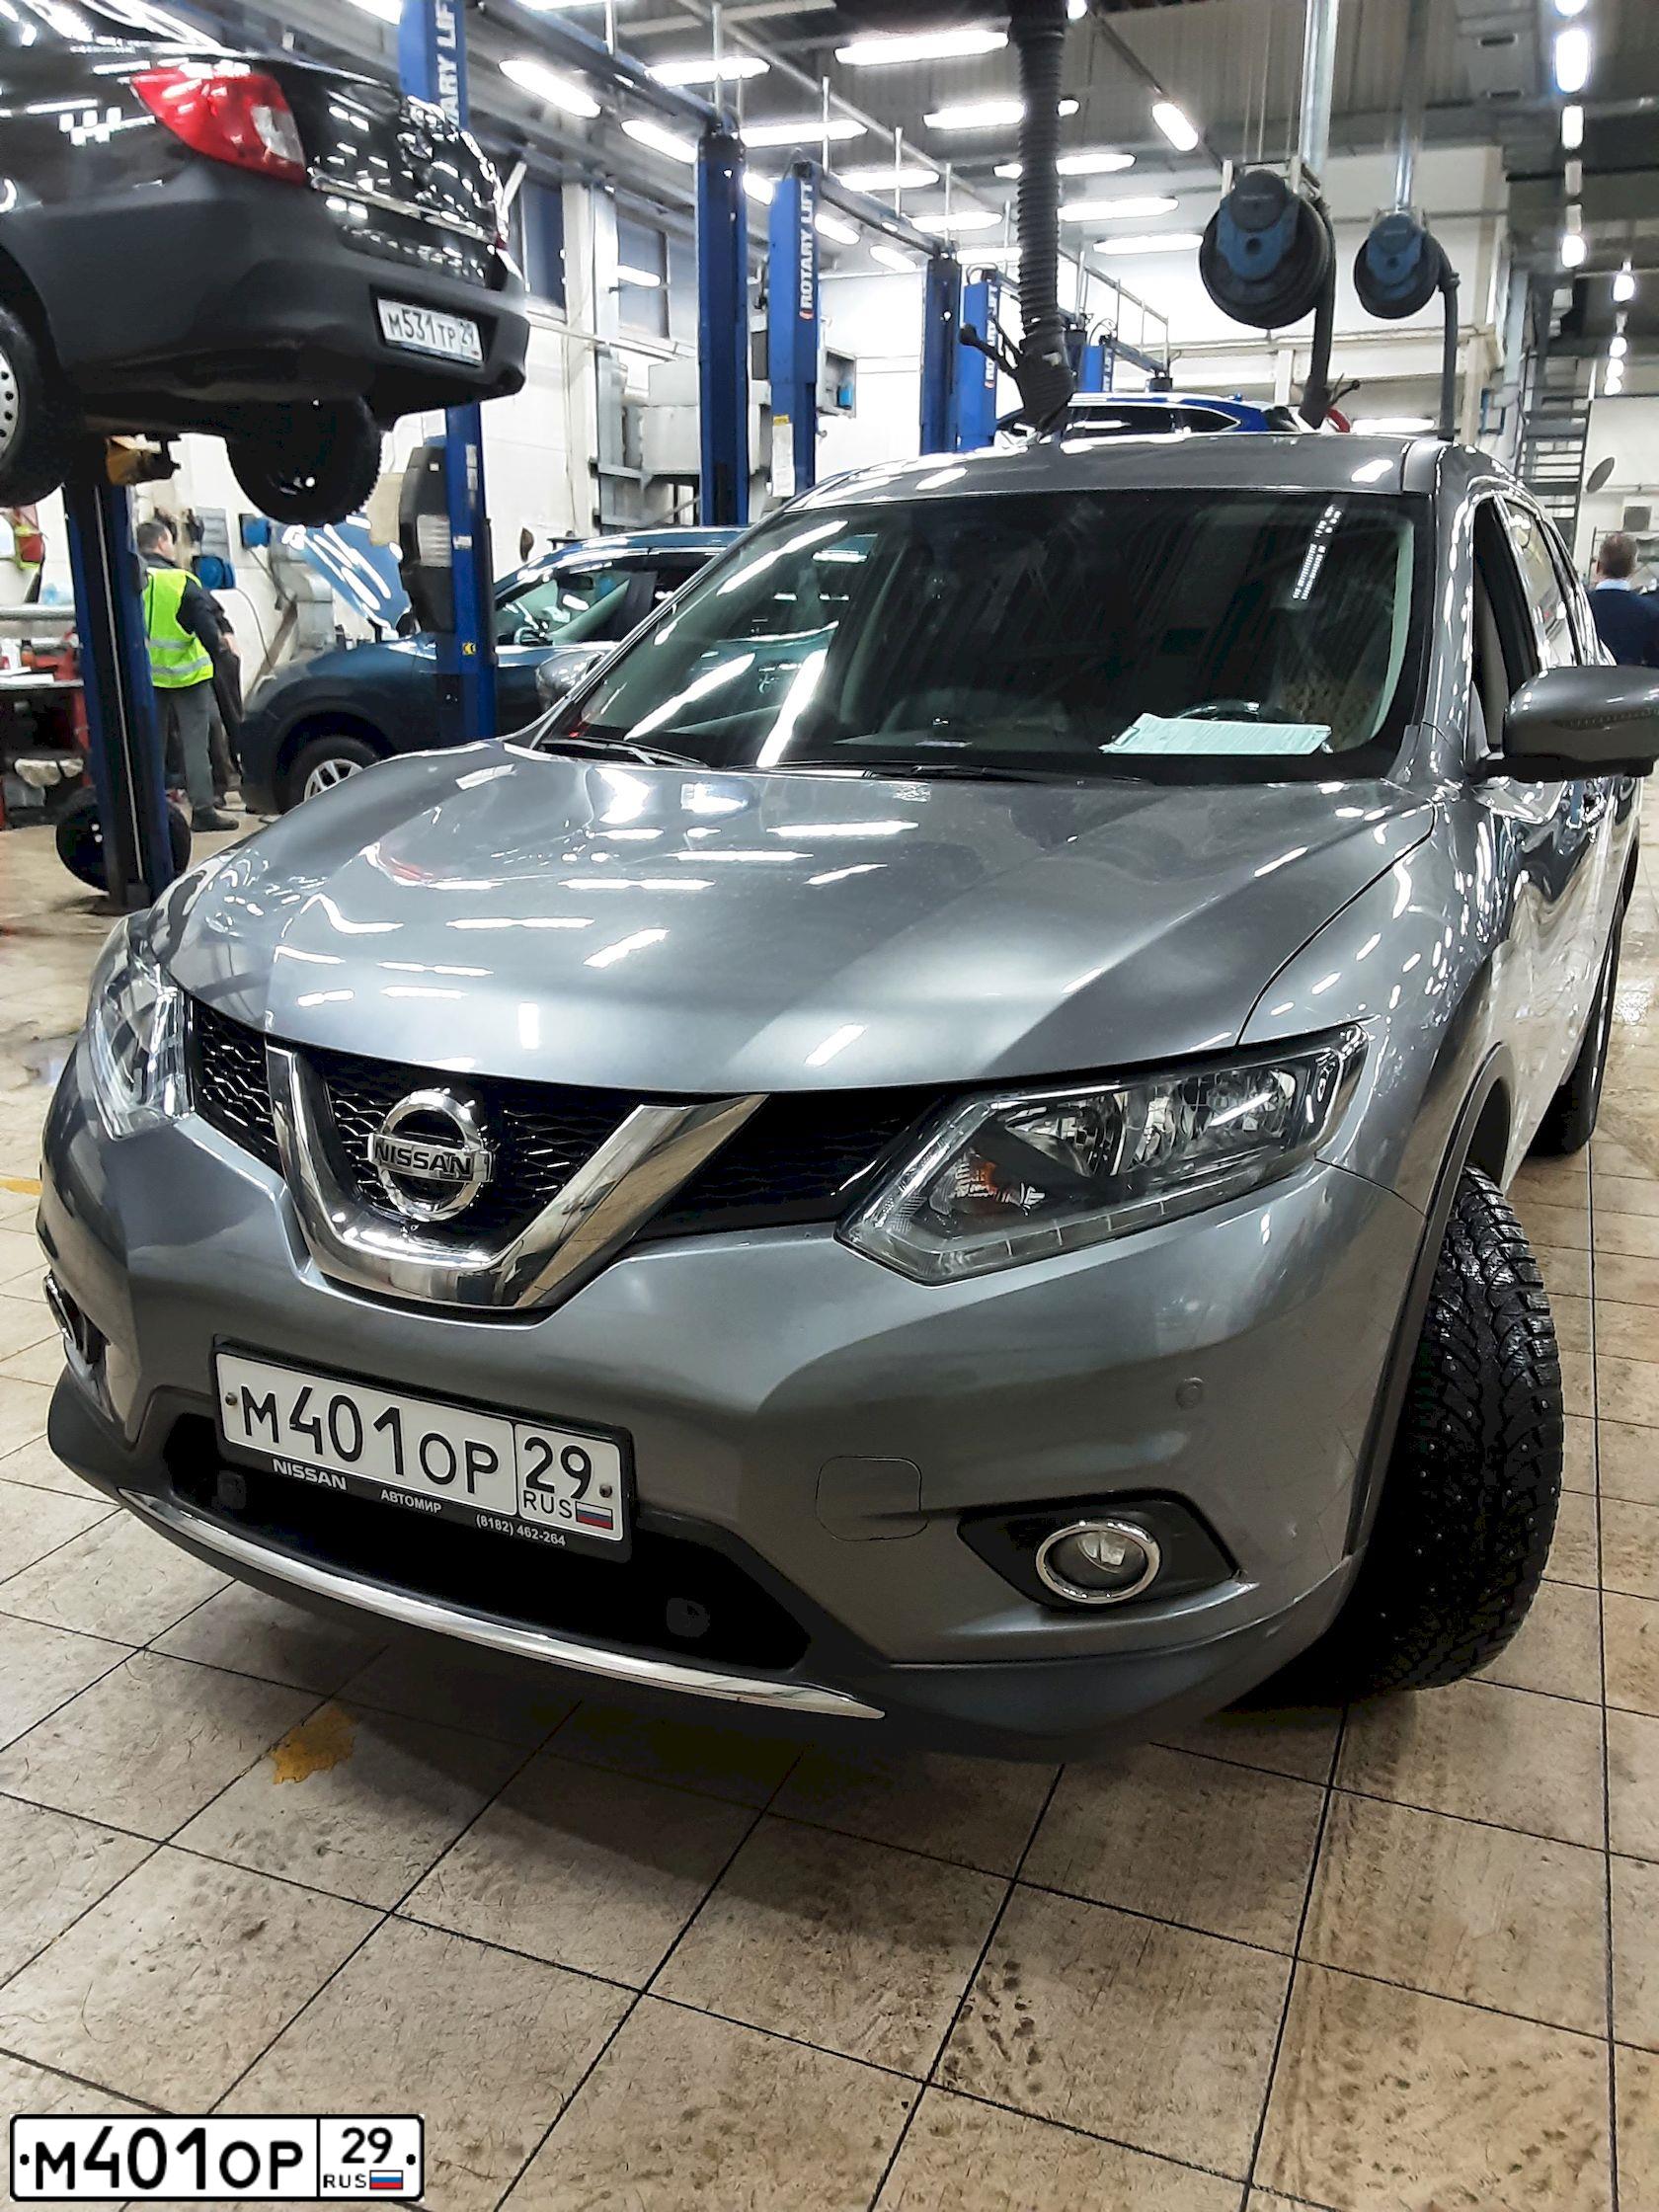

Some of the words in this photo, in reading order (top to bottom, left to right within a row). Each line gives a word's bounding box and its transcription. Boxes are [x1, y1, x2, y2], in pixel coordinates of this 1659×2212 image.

[434, 0, 456, 48] LIF
[437, 53, 460, 125] ARY
[800, 180, 813, 223] LIFT
[800, 228, 813, 308] ROTARY
[374, 1144, 471, 1175] NISSAN
[273, 1459, 347, 1490] NISSAN
[524, 1437, 592, 1499] 29
[380, 1489, 442, 1514] АВТОМИР
[523, 1490, 573, 1519] RUS
[476, 1514, 514, 1537] (8182)
[516, 1526, 566, 1546] 462-264
